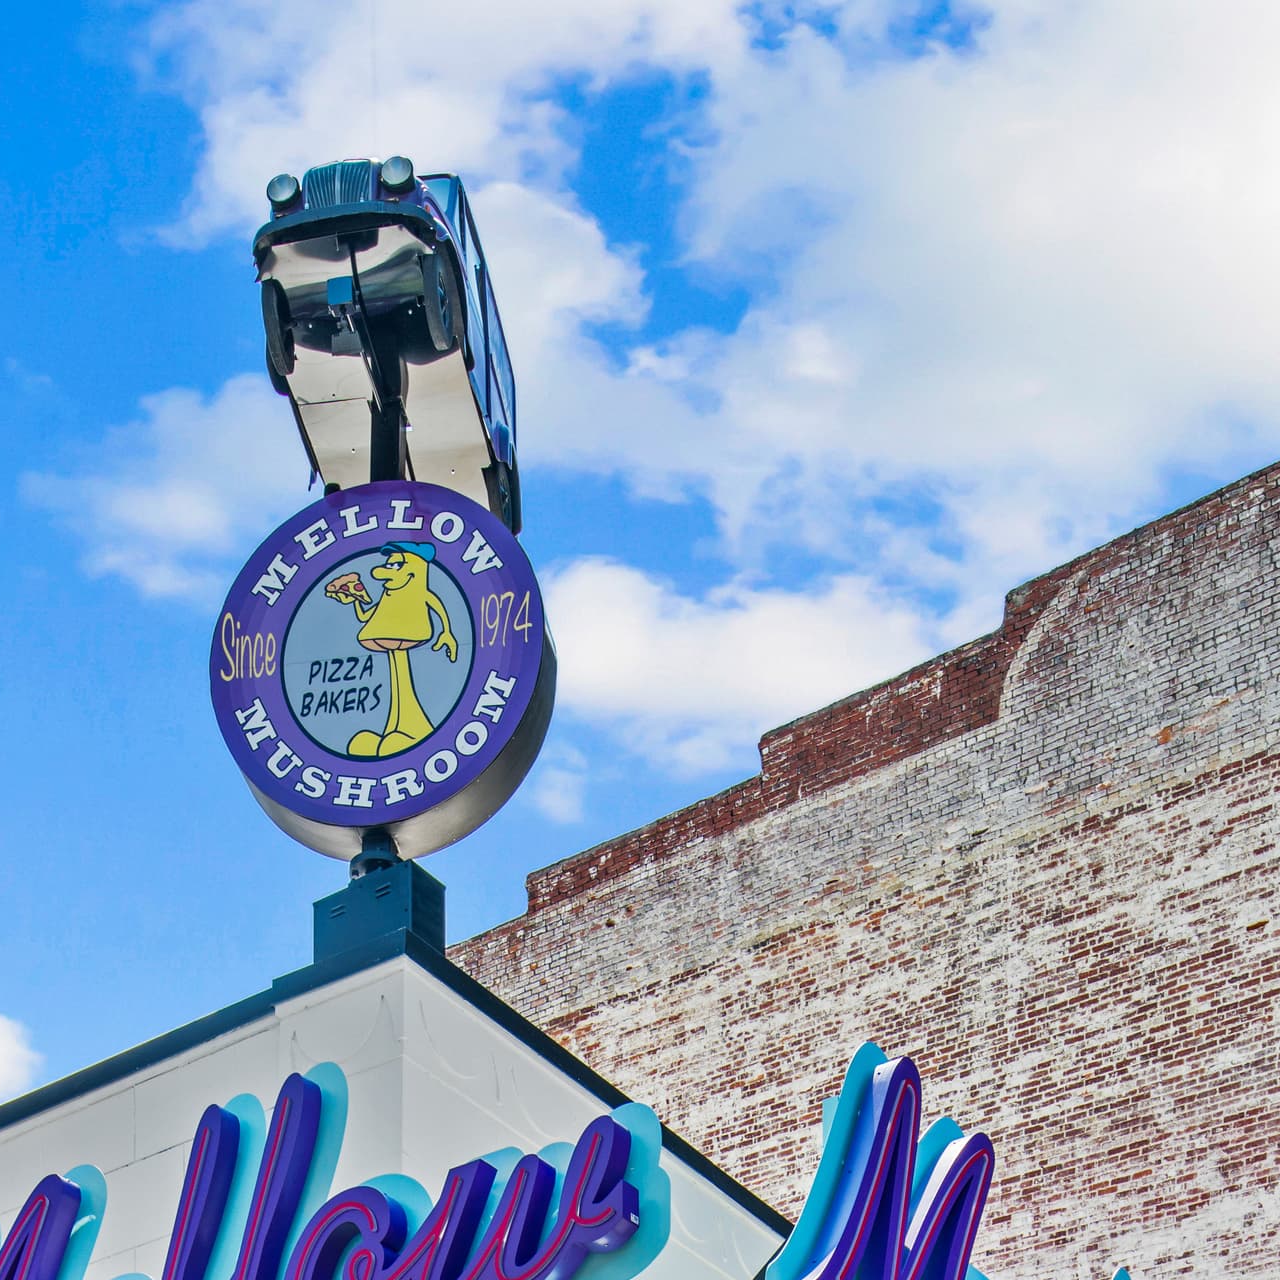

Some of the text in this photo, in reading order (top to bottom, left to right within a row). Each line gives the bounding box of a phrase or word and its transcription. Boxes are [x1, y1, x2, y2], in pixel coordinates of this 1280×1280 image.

[251, 499, 503, 607] MELLOW
[220, 591, 532, 682] Since 1974
[308, 654, 374, 685] PIZZA
[234, 670, 517, 808] MUSHROOM
[300, 684, 382, 717] BAKERS
